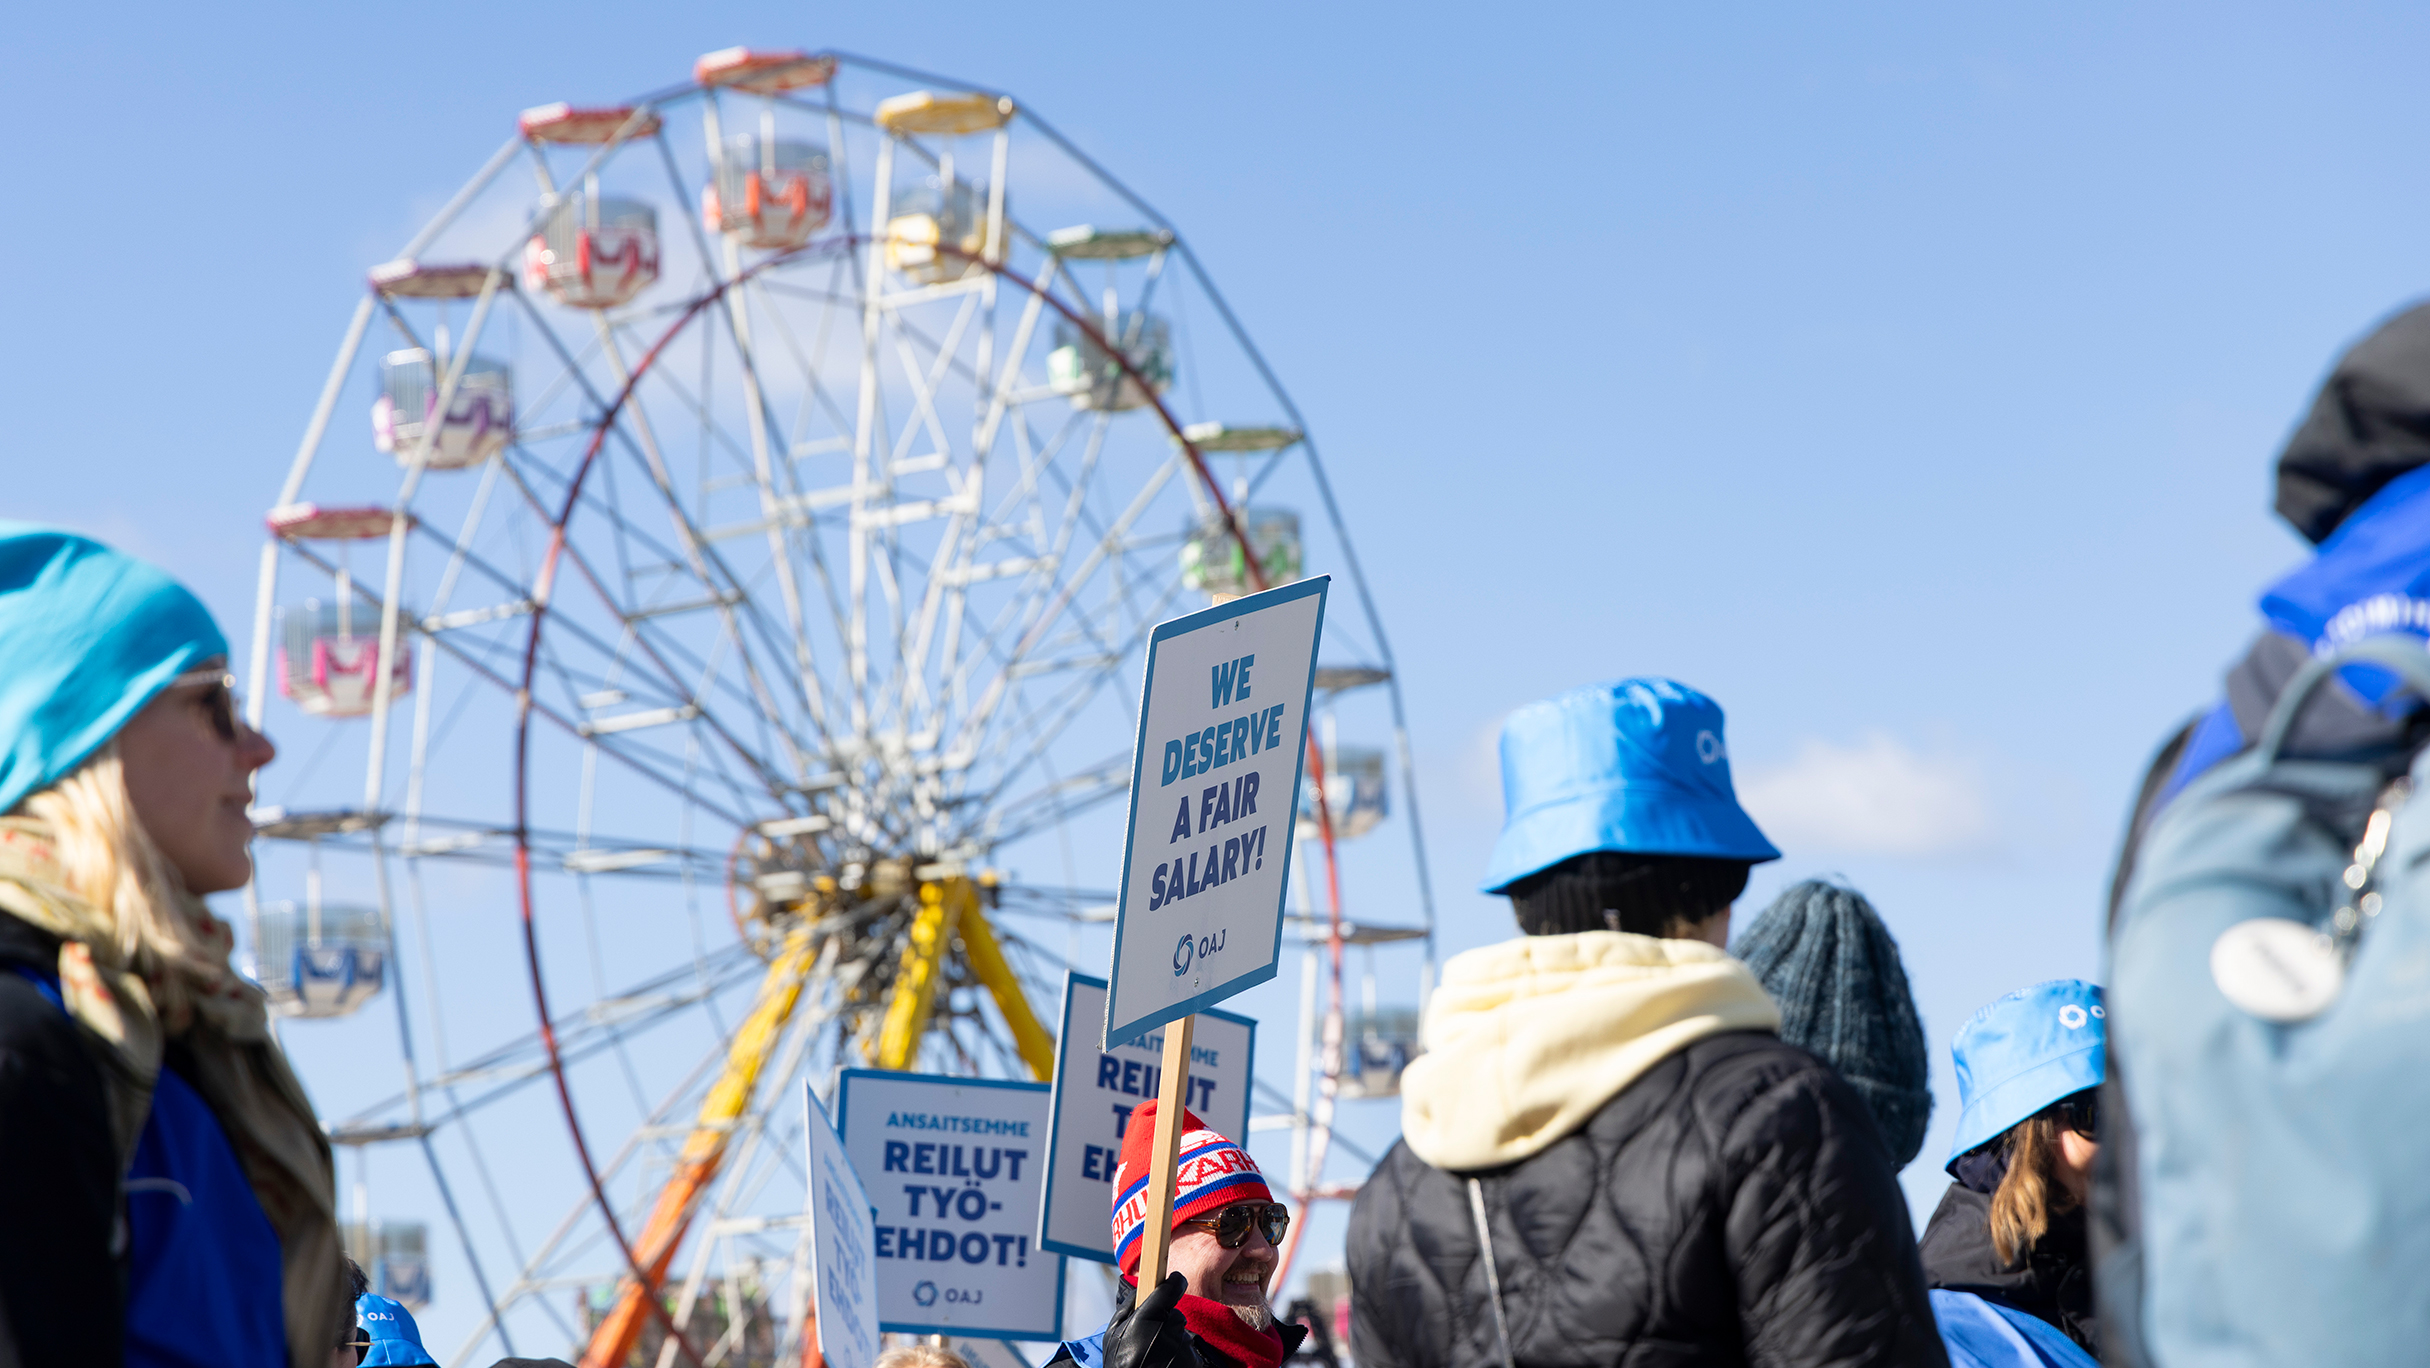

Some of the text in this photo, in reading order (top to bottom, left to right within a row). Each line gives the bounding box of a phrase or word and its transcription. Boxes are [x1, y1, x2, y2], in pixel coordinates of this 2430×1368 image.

[1211, 653, 1255, 710] WE
[1161, 702, 1285, 788] DESERVE
[1170, 771, 1260, 845] A FAIR
[1149, 825, 1267, 913] SALARY!
[1198, 928, 1227, 960] OAJ
[886, 1110, 1031, 1138] ANSAITSEMME
[883, 1139, 1029, 1182] REILUT
[903, 1178, 1003, 1221] TYÖ-
[874, 1225, 1029, 1269] EHDOT!
[367, 1312, 395, 1321] OAJ
[944, 1287, 983, 1305] OAJ
